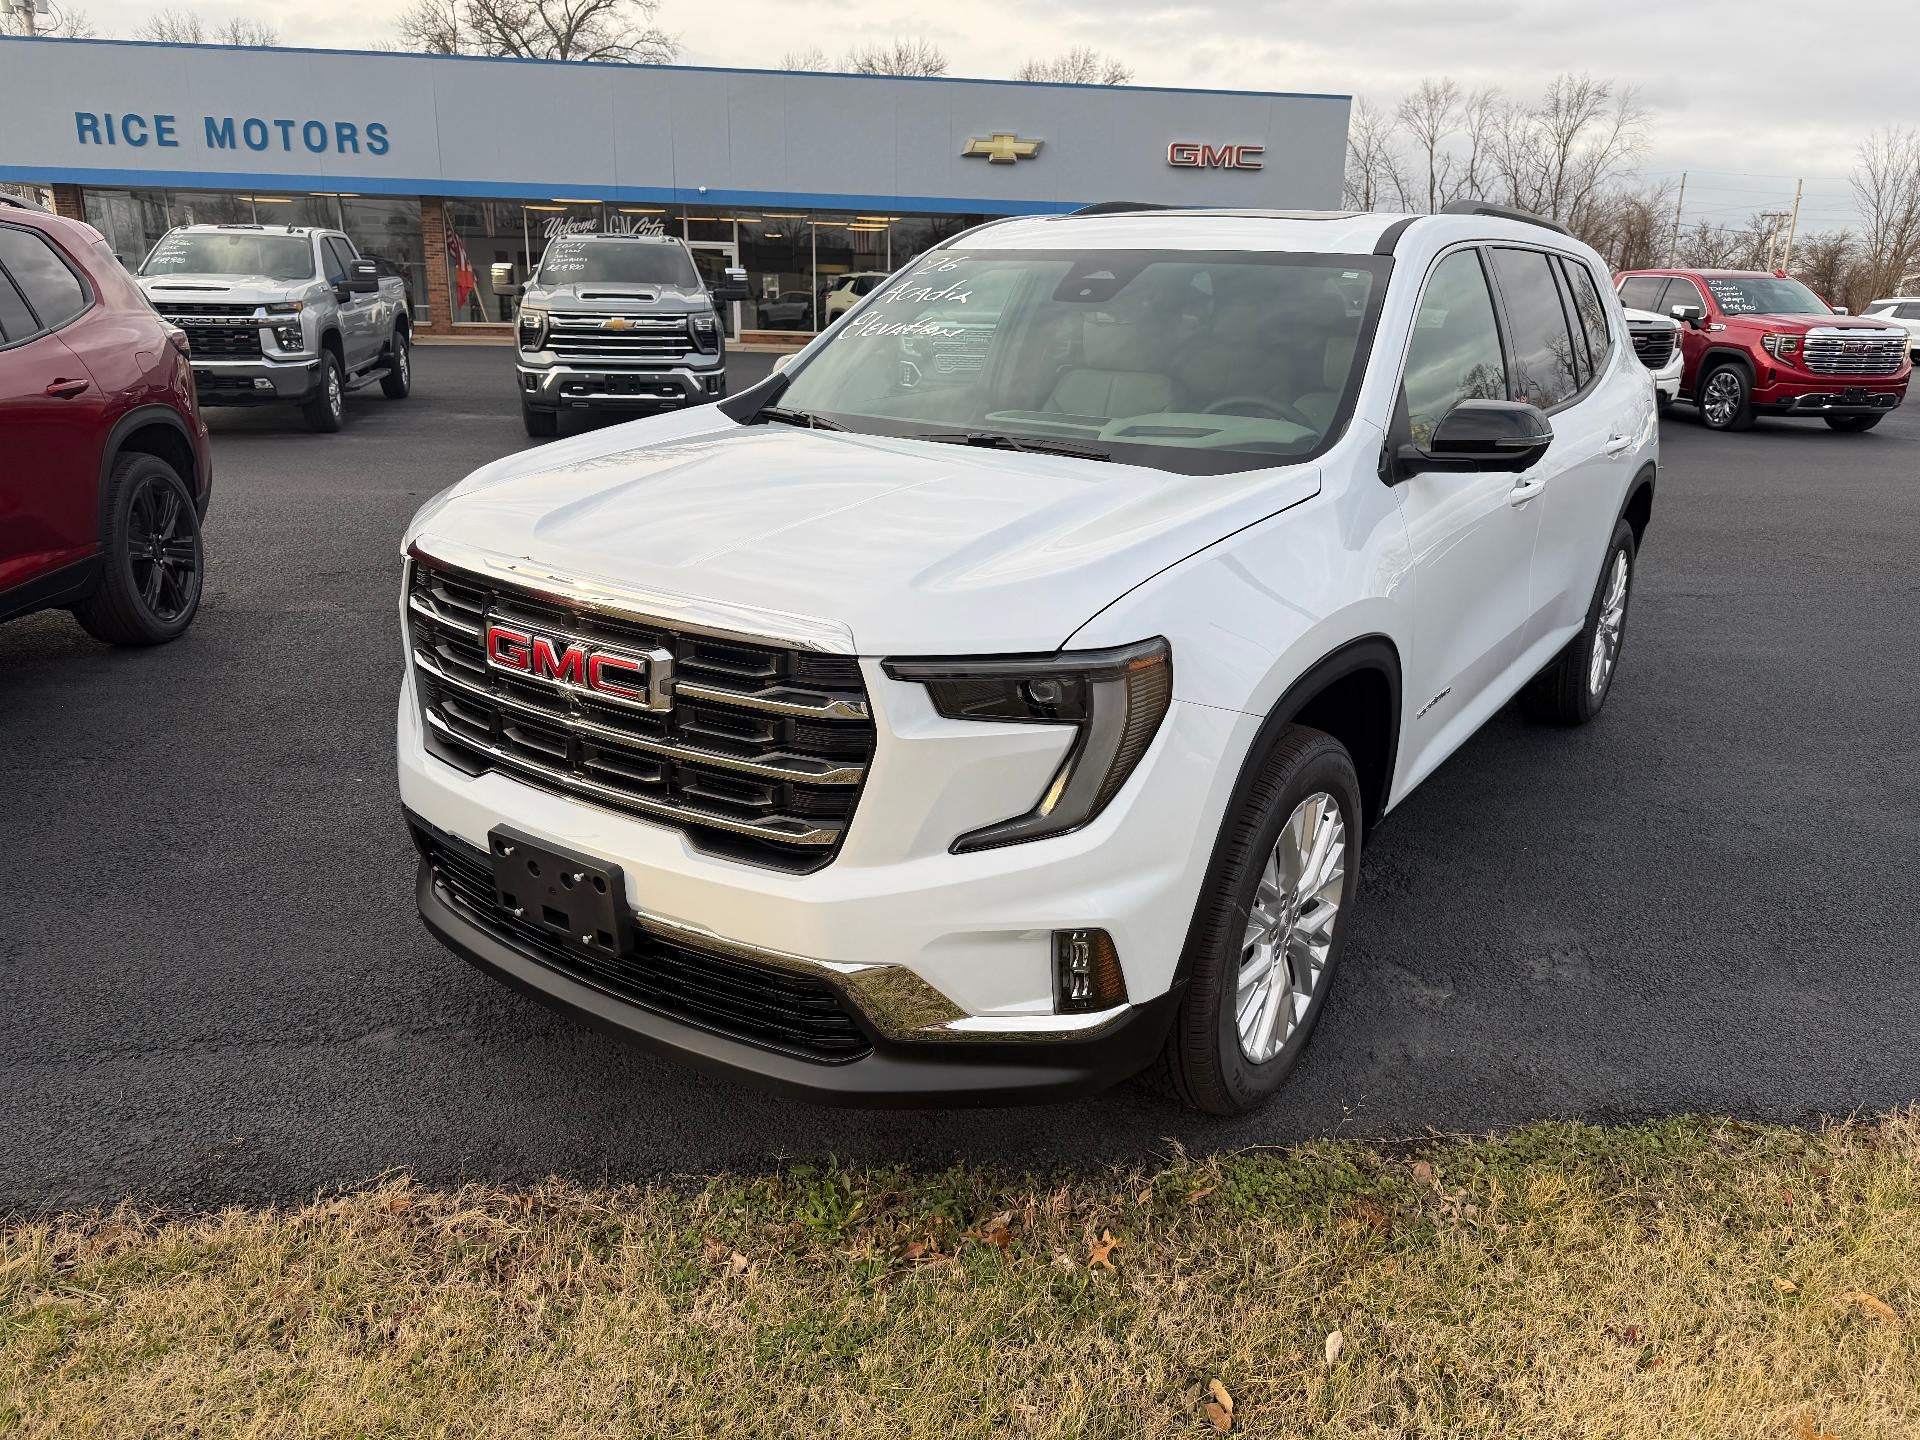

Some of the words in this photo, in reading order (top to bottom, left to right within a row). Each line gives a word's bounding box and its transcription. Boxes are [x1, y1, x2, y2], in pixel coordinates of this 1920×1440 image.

[75, 111, 179, 147] RICE
[204, 116, 391, 155] MOTORS
[1167, 141, 1265, 169] GMC
[542, 216, 597, 239] Welcome
[610, 215, 631, 234] GM
[631, 216, 666, 237] City
[876, 279, 973, 304] Acadia
[837, 310, 966, 340] Elevation
[486, 625, 643, 700] GMC
